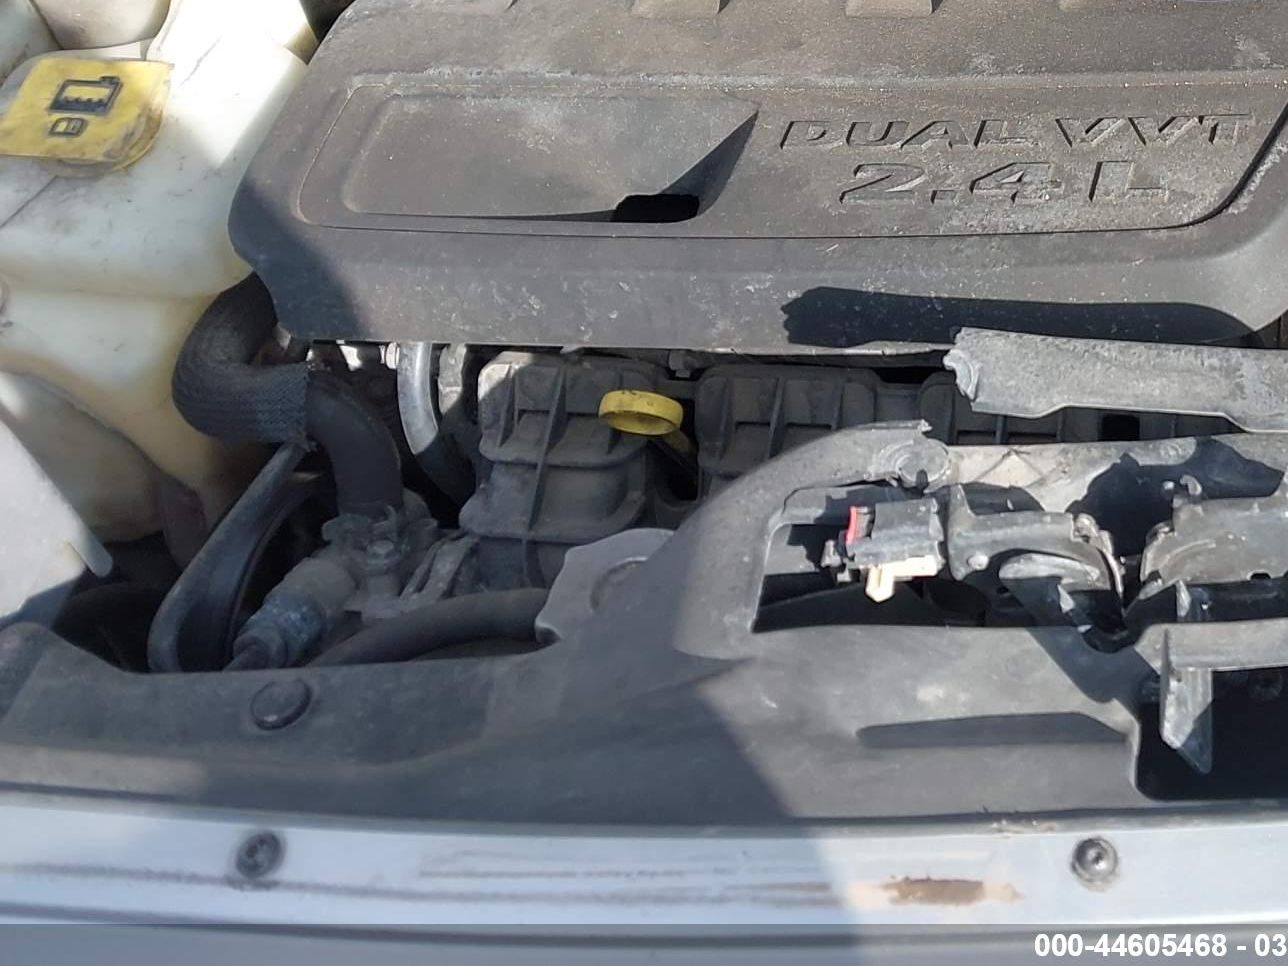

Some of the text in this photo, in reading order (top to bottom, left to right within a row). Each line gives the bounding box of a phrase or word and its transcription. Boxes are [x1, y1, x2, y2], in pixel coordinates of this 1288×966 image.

[780, 113, 1254, 151] DUAL VVT
[839, 160, 1168, 205] 2.4L
